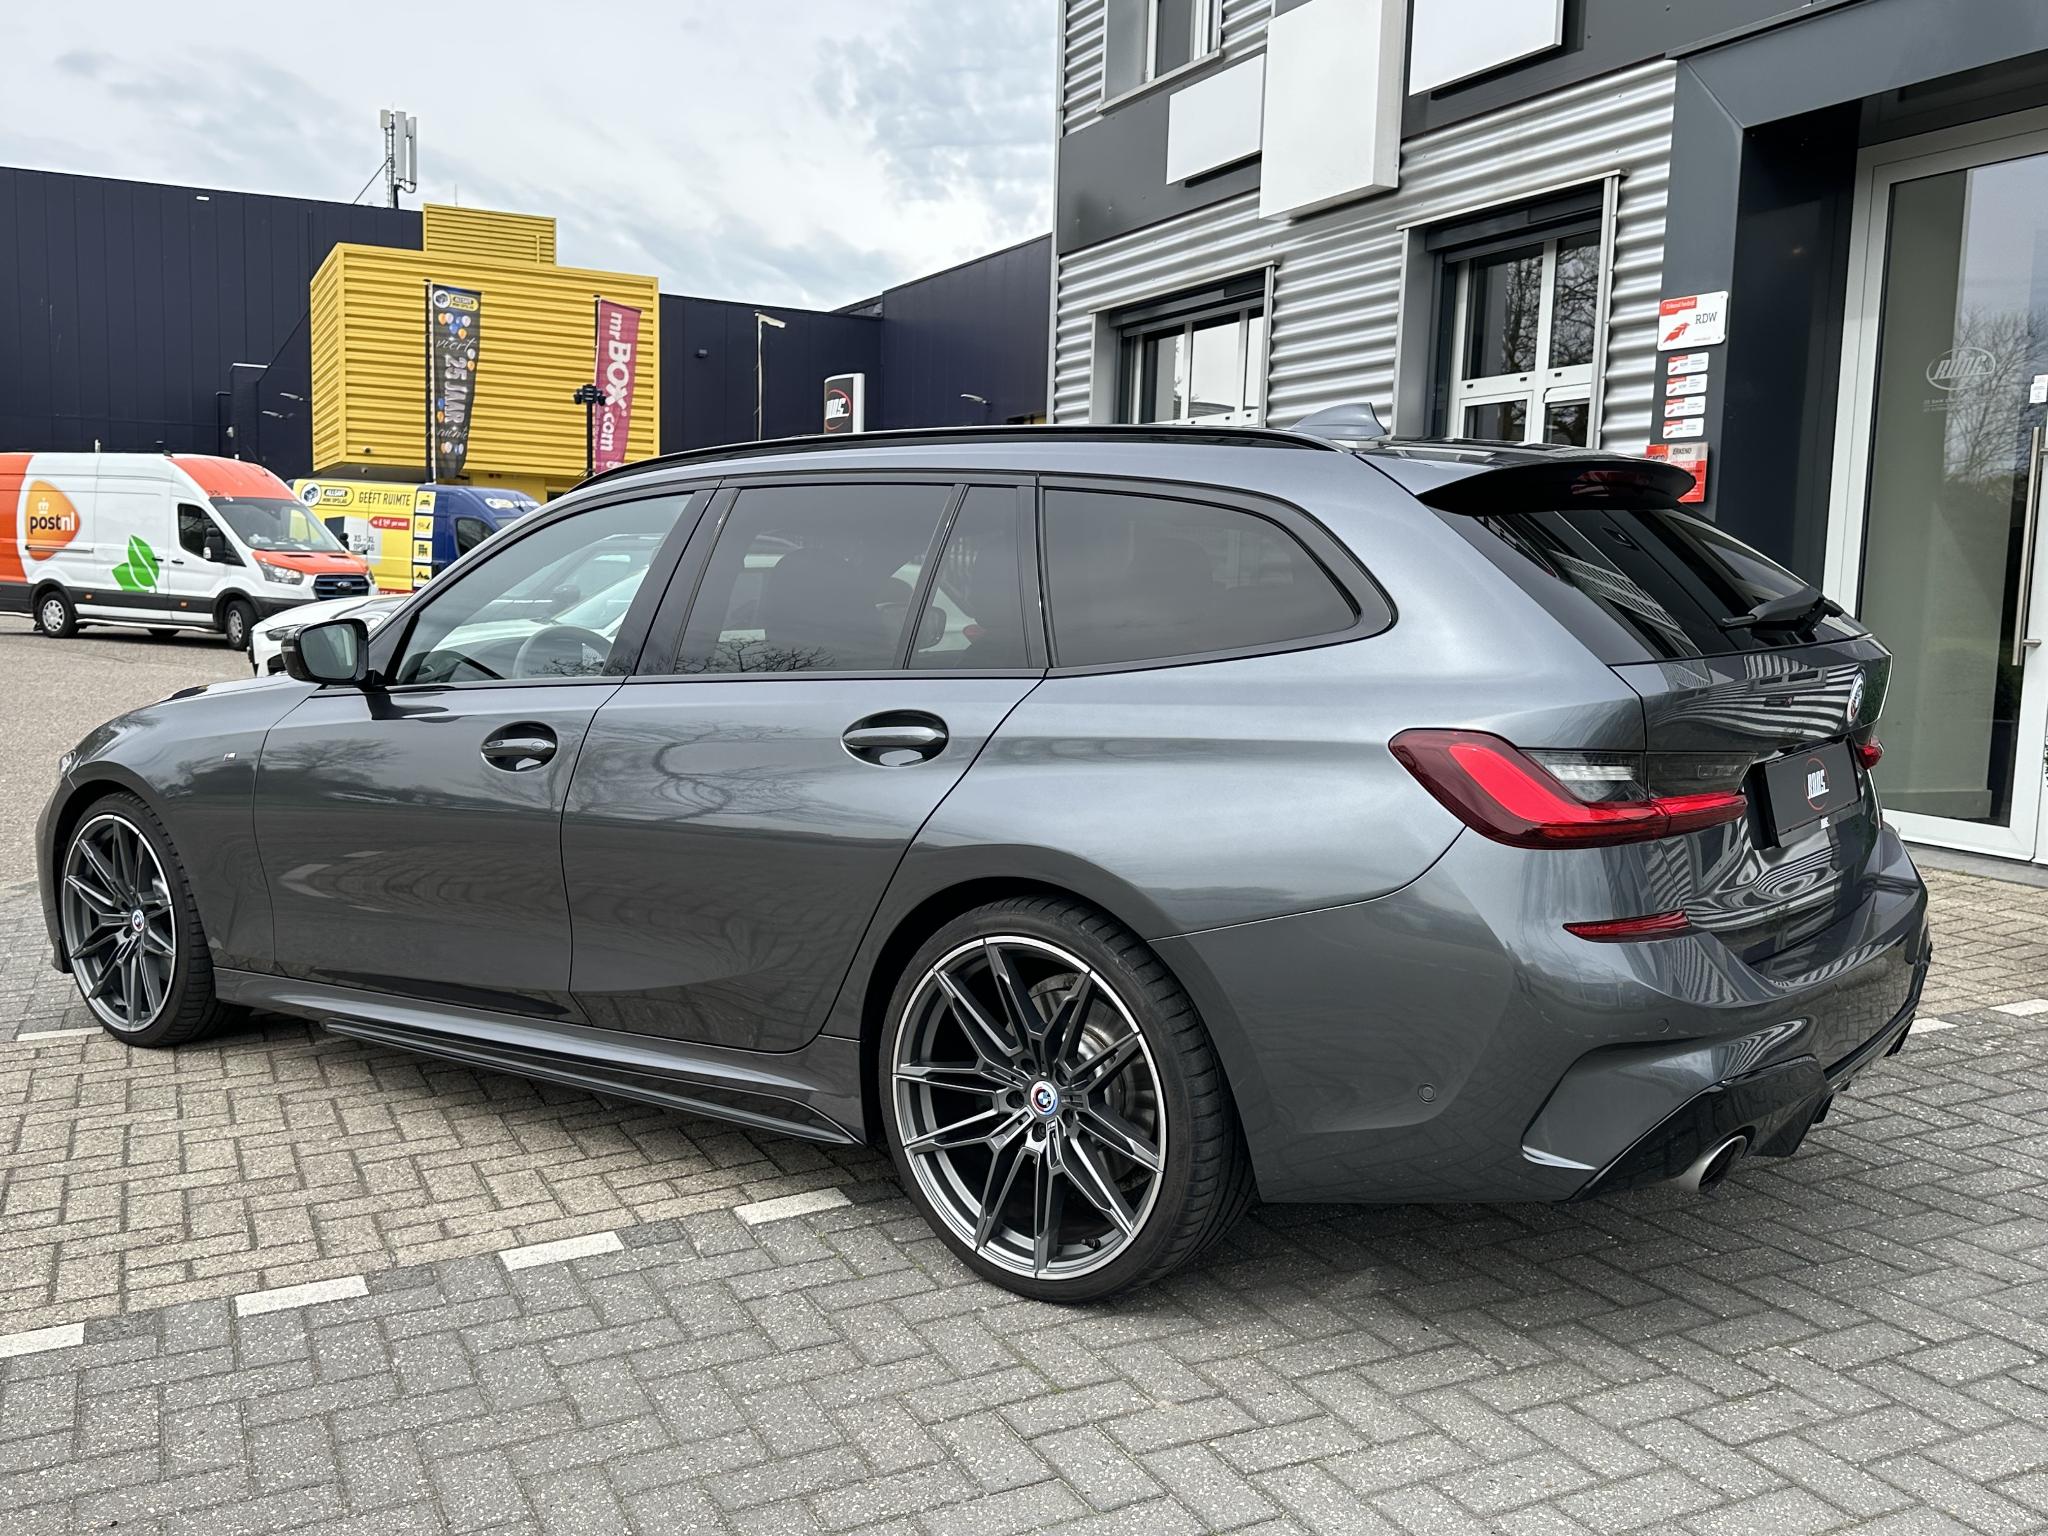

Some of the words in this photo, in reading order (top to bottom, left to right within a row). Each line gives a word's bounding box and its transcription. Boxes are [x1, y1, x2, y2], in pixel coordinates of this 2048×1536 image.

[1695, 312, 1718, 324] RDW
[444, 354, 467, 380] 25
[444, 382, 468, 423] JAAR
[358, 491, 382, 505] GEEFT
[383, 493, 412, 506] RUIMTE
[30, 512, 75, 535] postnl
